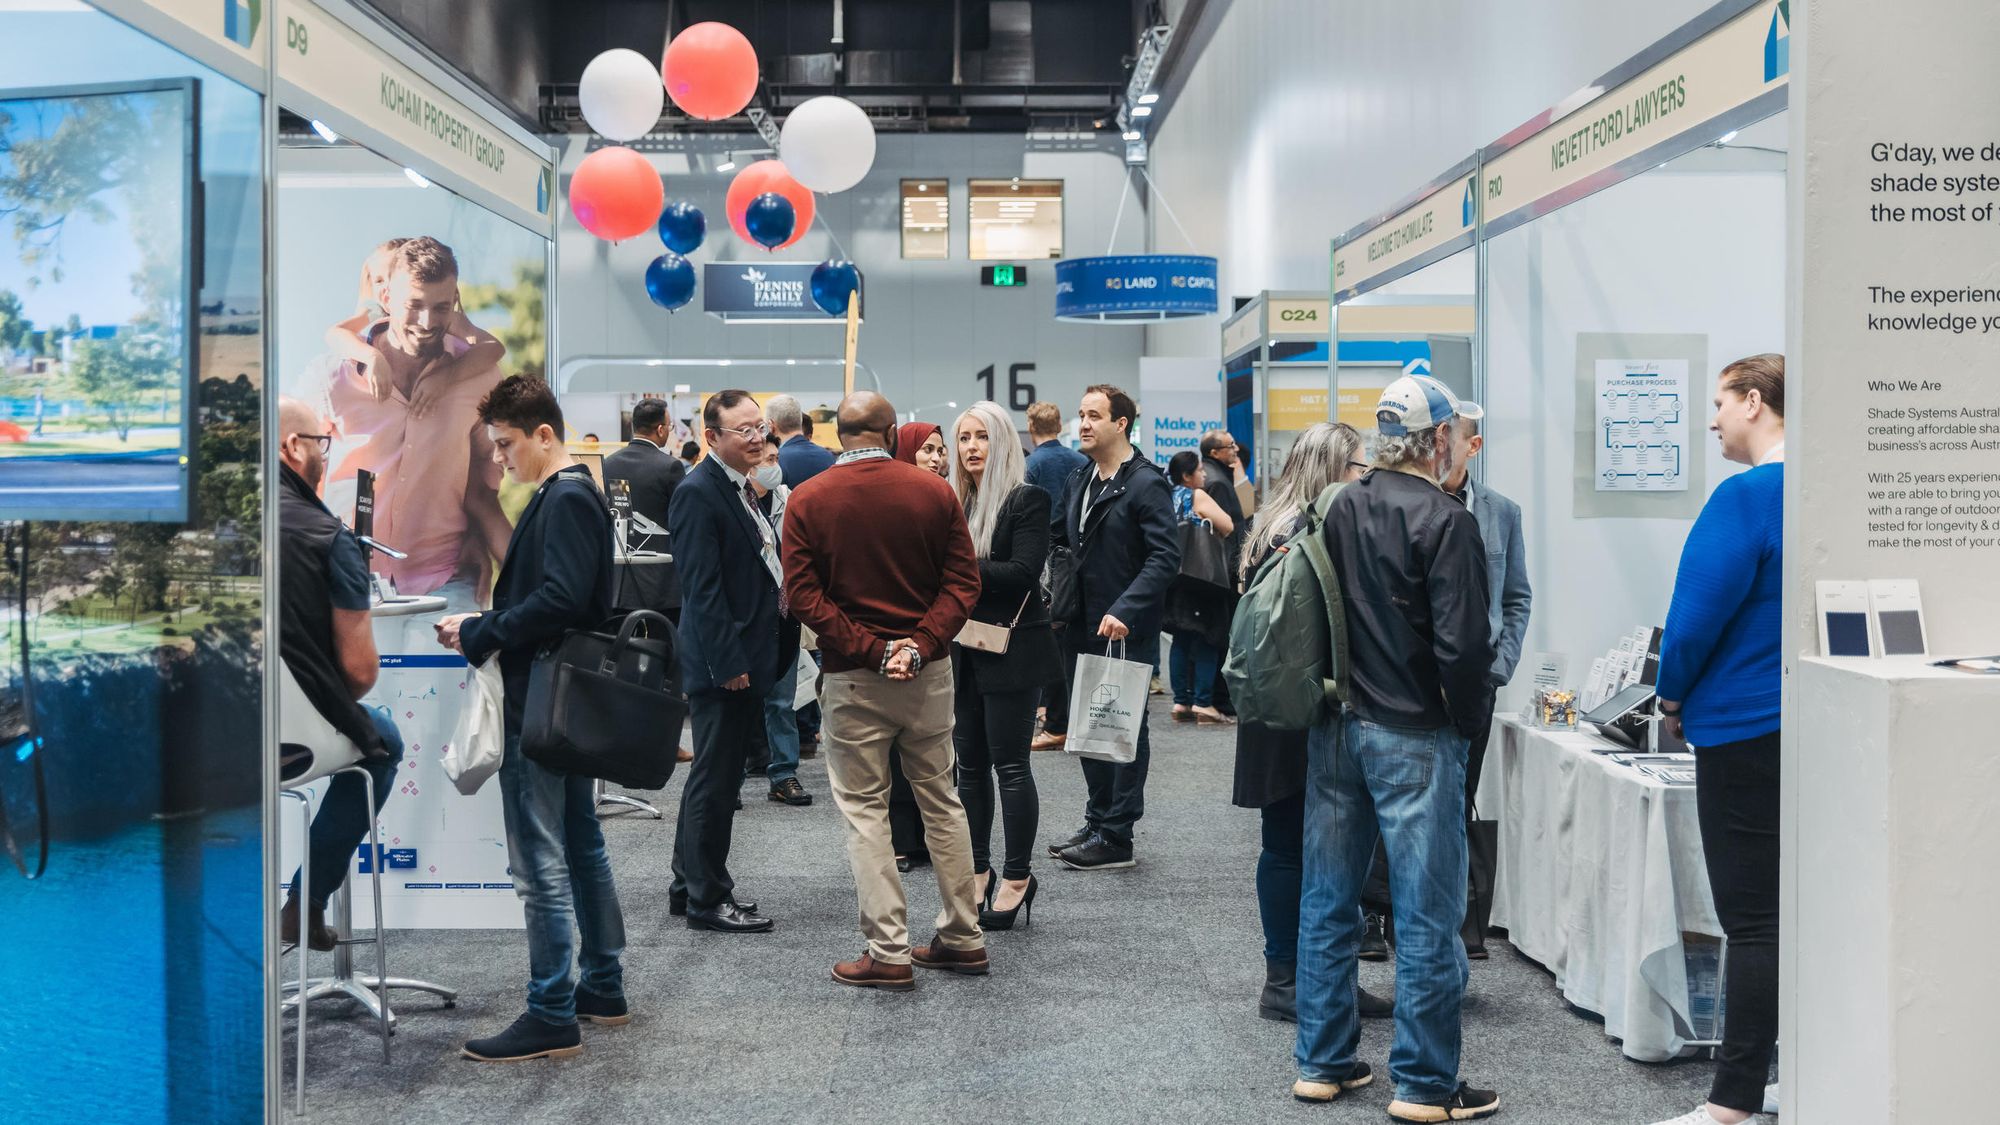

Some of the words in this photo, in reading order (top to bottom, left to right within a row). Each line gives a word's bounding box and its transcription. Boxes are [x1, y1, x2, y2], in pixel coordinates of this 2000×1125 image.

[286, 16, 308, 55] D9
[380, 72, 422, 127] KOHAM
[424, 101, 474, 157] PROPERTY
[475, 133, 505, 174] GROUP
[1551, 127, 1590, 172] NEVETT
[1592, 109, 1623, 151] FORD
[1626, 74, 1686, 134] LAWYERS
[1870, 142, 1937, 167] G'day,
[1942, 146, 1975, 162] we
[1488, 174, 1503, 201] R10
[1870, 173, 1938, 193] shade
[1942, 173, 2000, 196] syste
[1870, 203, 1906, 222] the
[1911, 203, 1967, 222] most
[1971, 202, 1994, 222] of
[1367, 235, 1393, 262] WELCOME
[1394, 229, 1401, 250] TO
[754, 280, 804, 292] DENNIS
[1124, 276, 1158, 289] LAND
[754, 291, 804, 301] FAMILY
[1867, 286, 1906, 304] The
[1281, 309, 1318, 321] C24
[1868, 313, 1977, 335] knowledge
[976, 363, 1036, 411] 16
[1867, 380, 1896, 392] Who
[1898, 380, 1918, 392] We
[1920, 379, 1942, 392] Are
[1324, 394, 1360, 404] HMES
[1867, 407, 1906, 419] Shade
[1907, 407, 1958, 421] Systems
[1154, 416, 1197, 431] Make
[1867, 424, 1915, 438] creating
[1917, 423, 1977, 435] affordable
[1154, 434, 1199, 447] house
[1867, 440, 1927, 452] business's
[1929, 441, 1968, 451] across
[1867, 472, 1895, 484] With
[1897, 472, 1912, 483] 25
[1914, 474, 1946, 486] years
[1947, 472, 2000, 485] experien
[1867, 490, 1886, 500] we
[1887, 490, 1907, 500] are
[1908, 489, 1934, 499] able
[1936, 488, 1948, 499] to
[1950, 488, 1981, 502] bring
[1867, 505, 1893, 516] with
[1895, 506, 1902, 515] a
[1904, 506, 1938, 518] range
[1940, 504, 1952, 515] of
[1954, 504, 2000, 515] outdoor
[1868, 521, 1905, 532] tested
[1907, 521, 1923, 531] for
[1925, 520, 1978, 534] longevity
[1980, 519, 1990, 531] &
[1868, 537, 1900, 548] make
[1902, 537, 1922, 547] the
[1923, 537, 1953, 548] most
[1955, 536, 1967, 547] of
[1969, 538, 1995, 550] your
[1116, 709, 1131, 717] LAND
